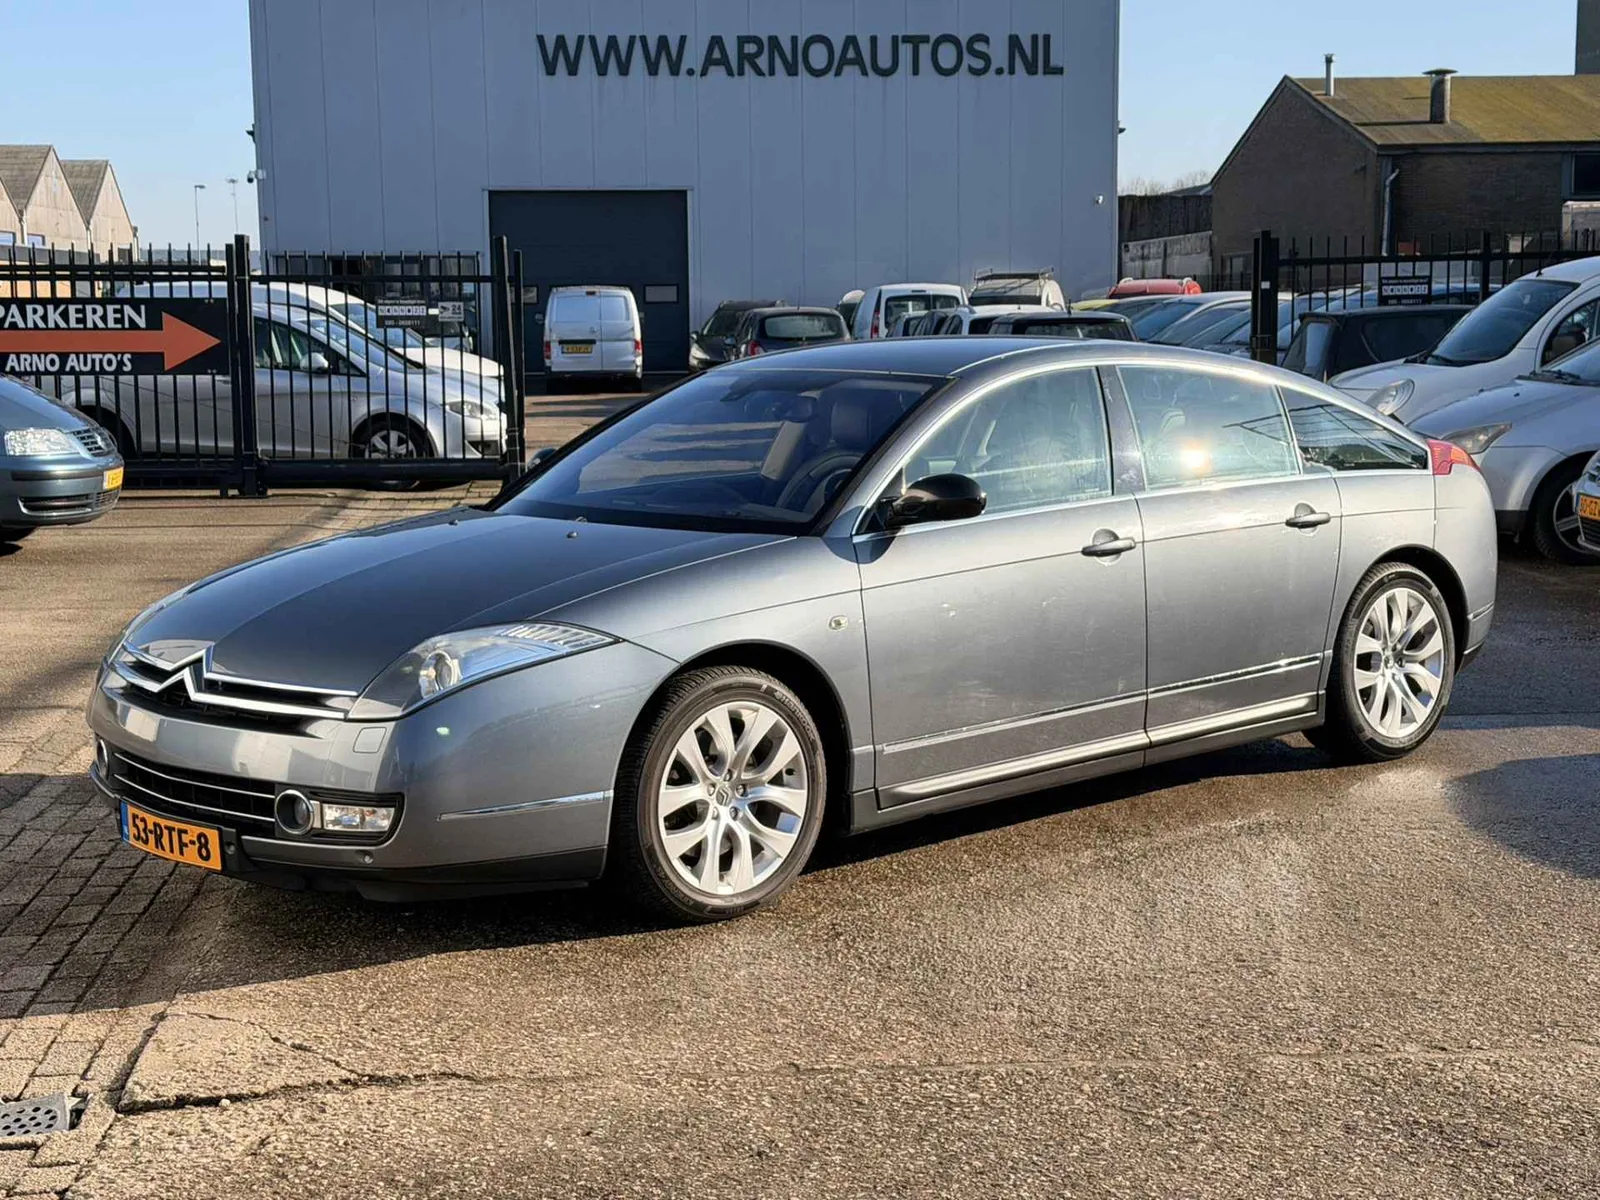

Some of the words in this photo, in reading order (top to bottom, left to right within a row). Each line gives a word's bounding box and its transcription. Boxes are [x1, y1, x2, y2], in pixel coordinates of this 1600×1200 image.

[536, 33, 1064, 77] WWW.ARNOAUTOS.NL
[0, 304, 146, 329] ARKEREN
[5, 353, 60, 372] ARNO
[65, 353, 132, 372] AUTO'S
[131, 812, 212, 862] 53-RTF-8
